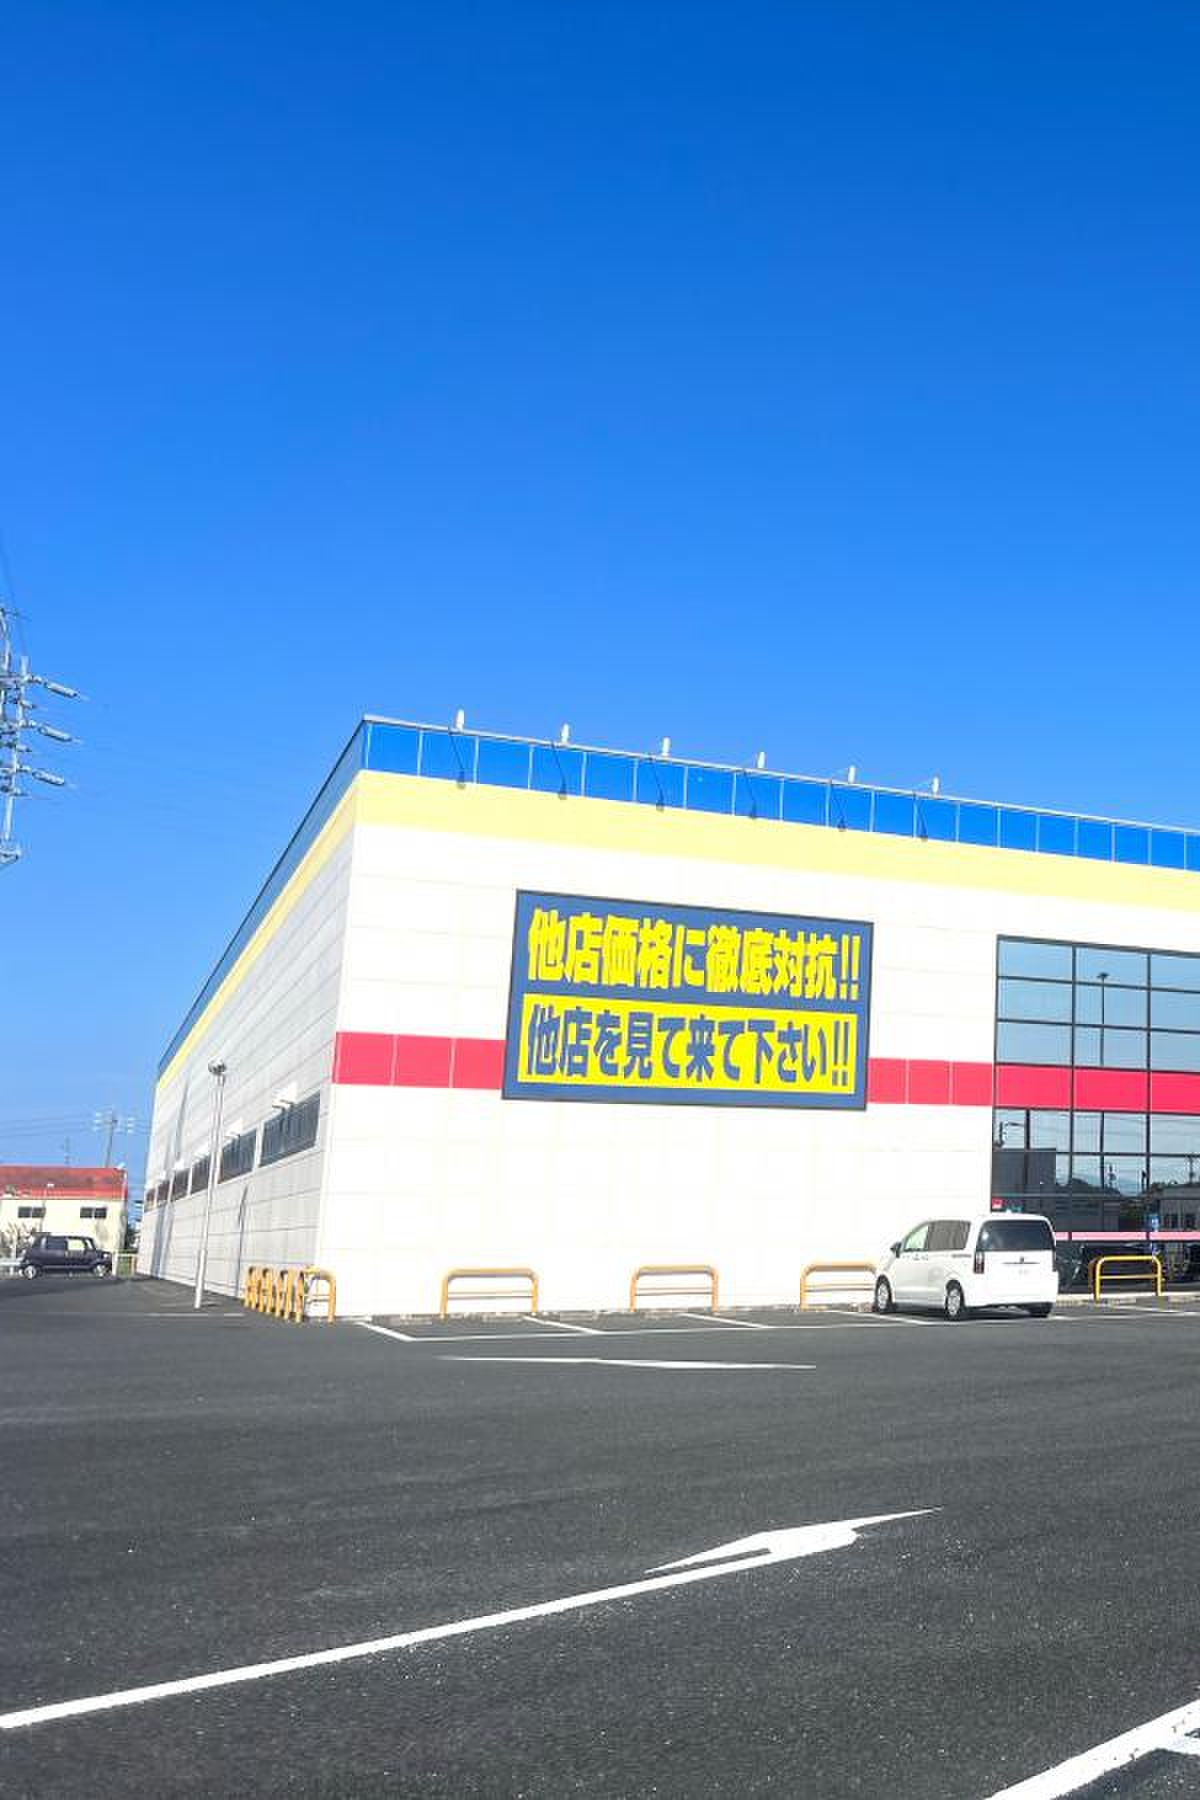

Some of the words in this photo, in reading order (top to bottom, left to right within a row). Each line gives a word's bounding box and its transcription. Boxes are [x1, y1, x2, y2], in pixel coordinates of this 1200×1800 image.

[527, 907, 861, 1001] 他店価格に徹底対抗!!
[526, 1003, 850, 1087] 他店を見て来て下さい!!
